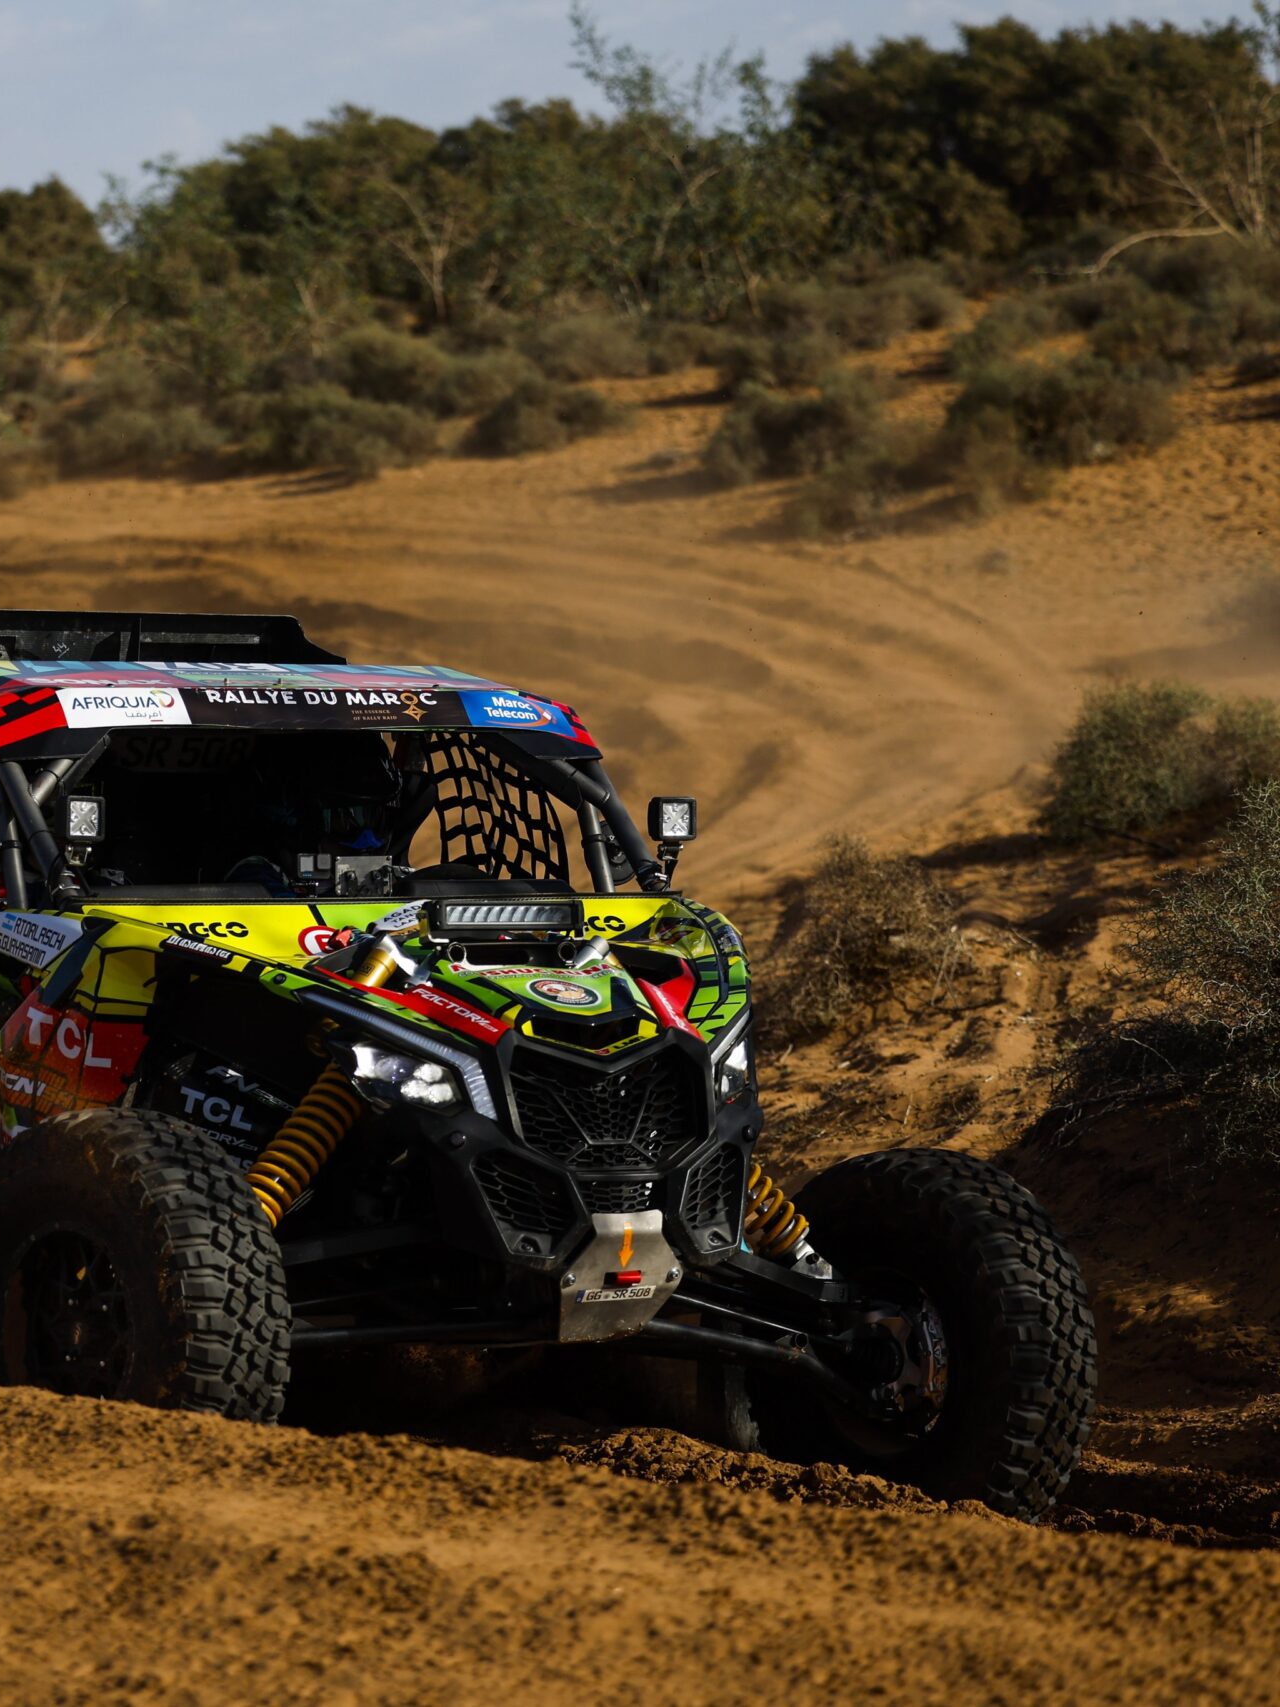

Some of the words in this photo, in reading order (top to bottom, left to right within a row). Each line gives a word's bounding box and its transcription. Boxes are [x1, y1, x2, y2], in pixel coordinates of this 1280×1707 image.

[71, 696, 159, 710] AFRIQUIA
[204, 690, 298, 705] RALLYE
[303, 691, 338, 706] DU
[345, 691, 438, 706] MAROC
[491, 696, 533, 711] Maroc
[483, 706, 538, 721] Telecom
[411, 987, 489, 1026] FACTORY
[26, 1006, 112, 1069] TCL
[180, 1086, 252, 1132] TCL
[586, 1290, 603, 1301] GG
[612, 1289, 628, 1299] SR
[628, 1287, 651, 1298] 508
